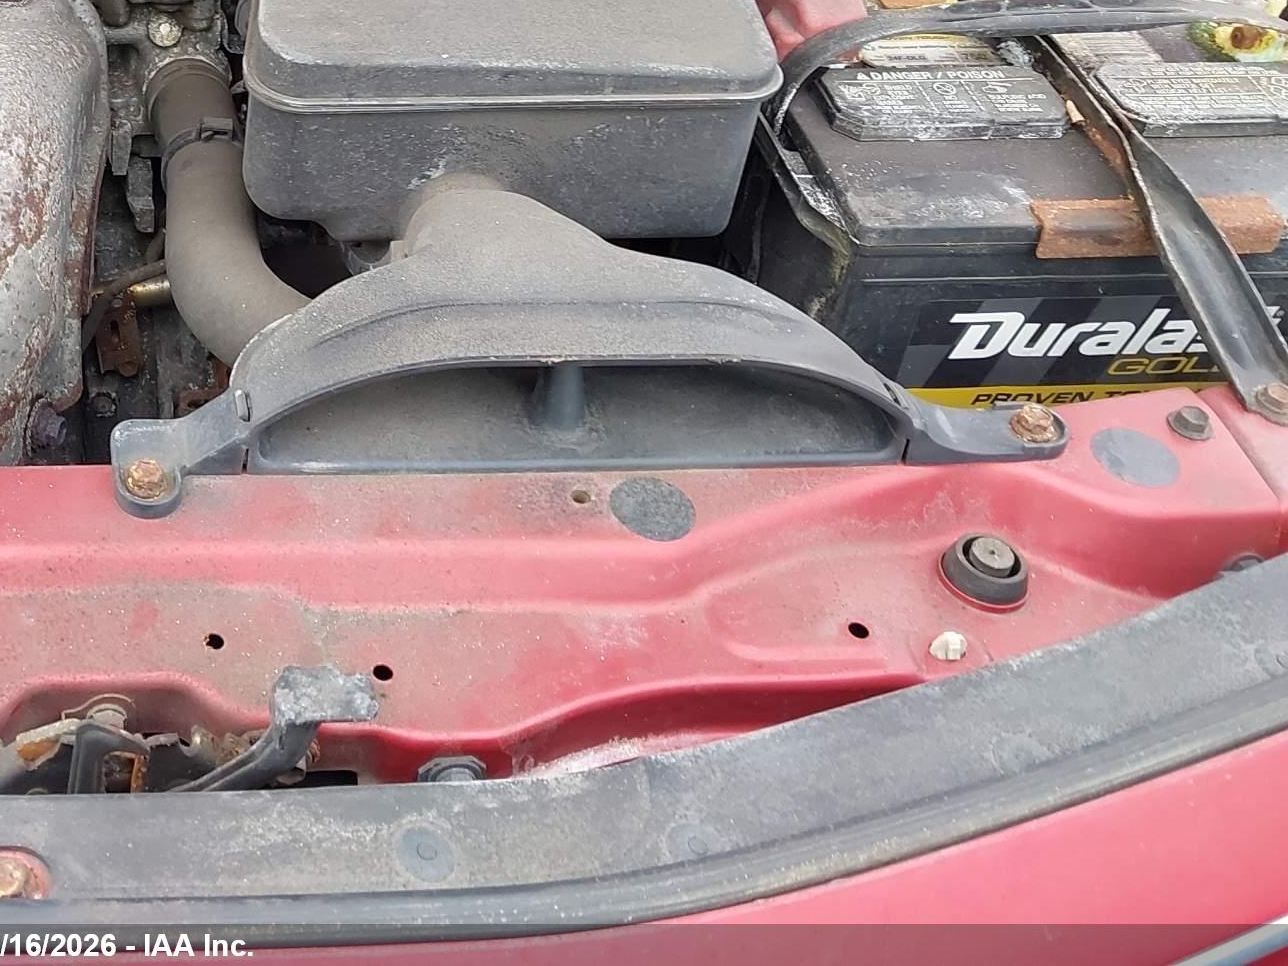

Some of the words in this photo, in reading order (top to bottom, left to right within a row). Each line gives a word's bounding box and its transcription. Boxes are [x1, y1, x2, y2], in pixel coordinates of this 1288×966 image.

[869, 71, 933, 80] DANGER
[948, 70, 1006, 79] POISON
[948, 306, 1280, 360] Durala
[1107, 356, 1221, 376] GOL
[970, 391, 1095, 406] PROVEN
